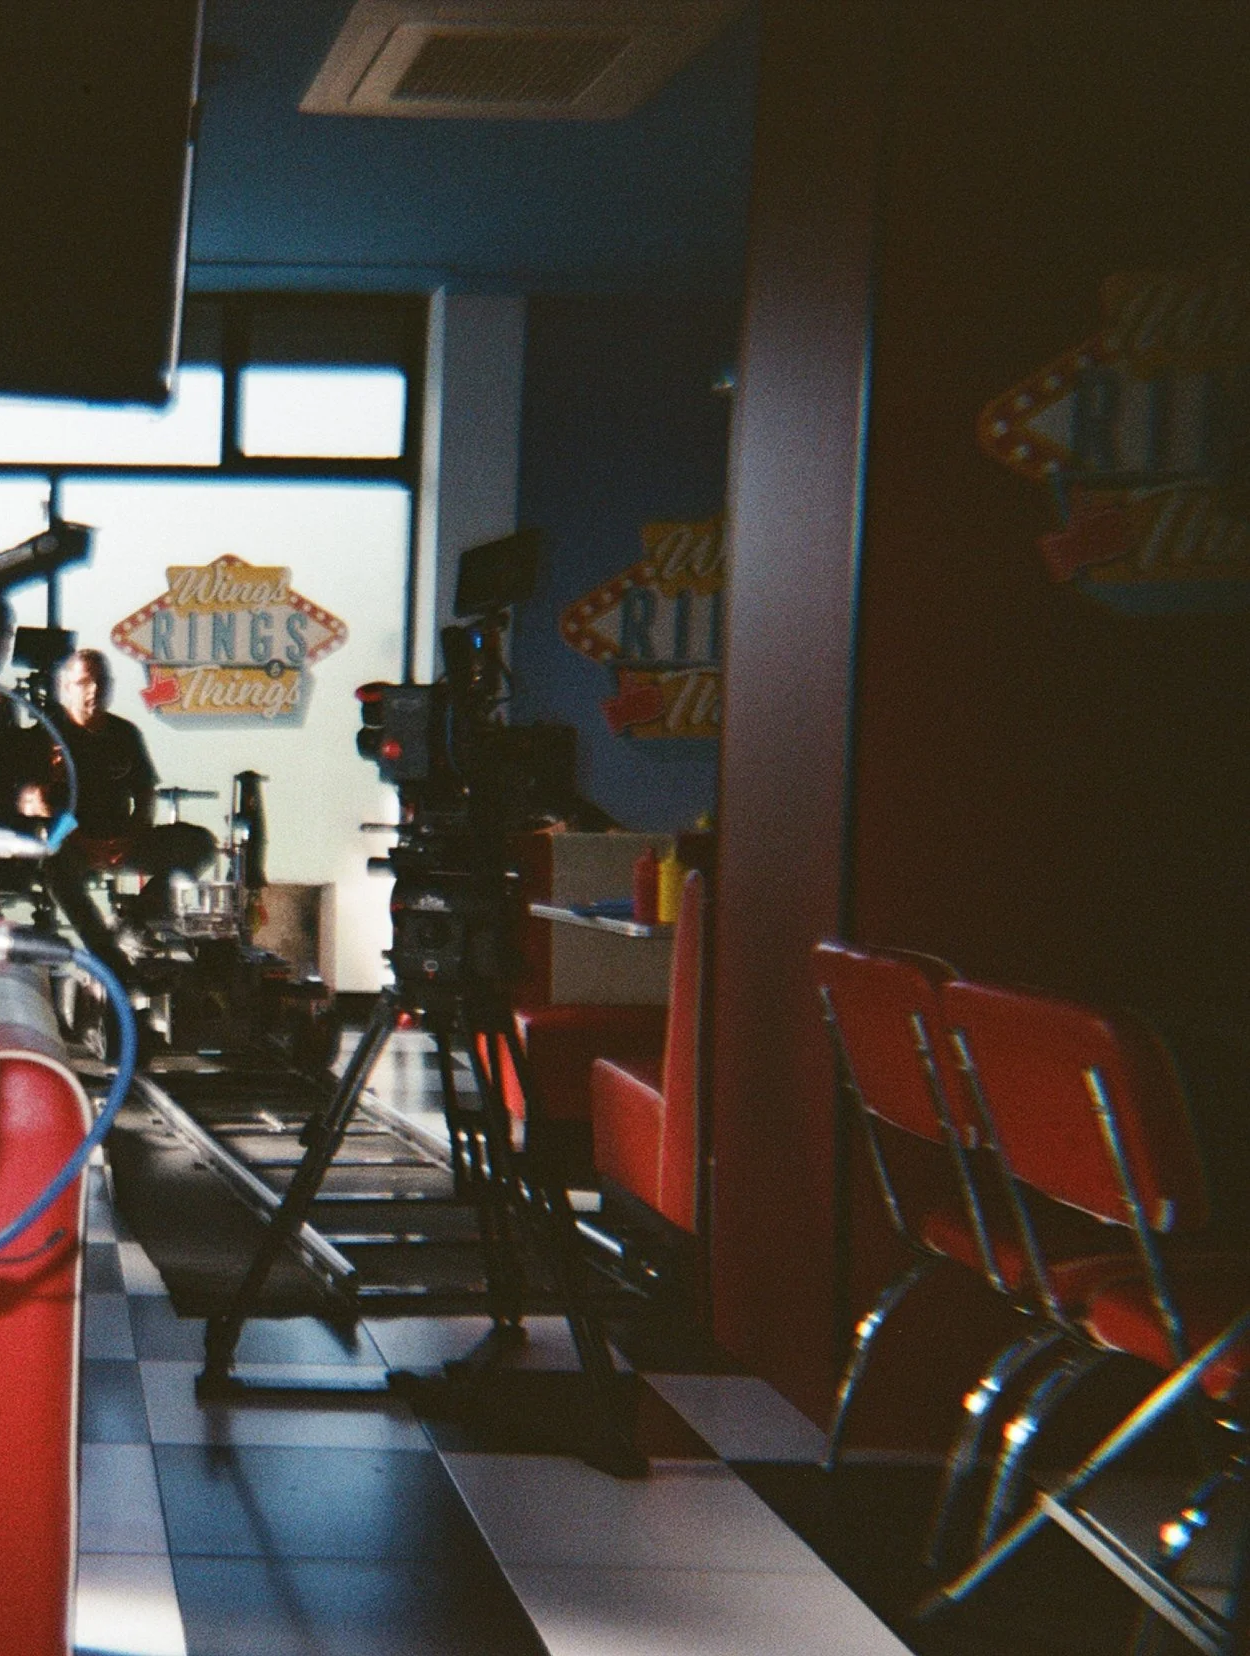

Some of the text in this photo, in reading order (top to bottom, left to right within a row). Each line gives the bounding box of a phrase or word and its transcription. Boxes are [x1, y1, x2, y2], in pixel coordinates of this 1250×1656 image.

[172, 561, 291, 610] Wings
[152, 609, 308, 665] RINGS
[175, 664, 300, 718] Things
